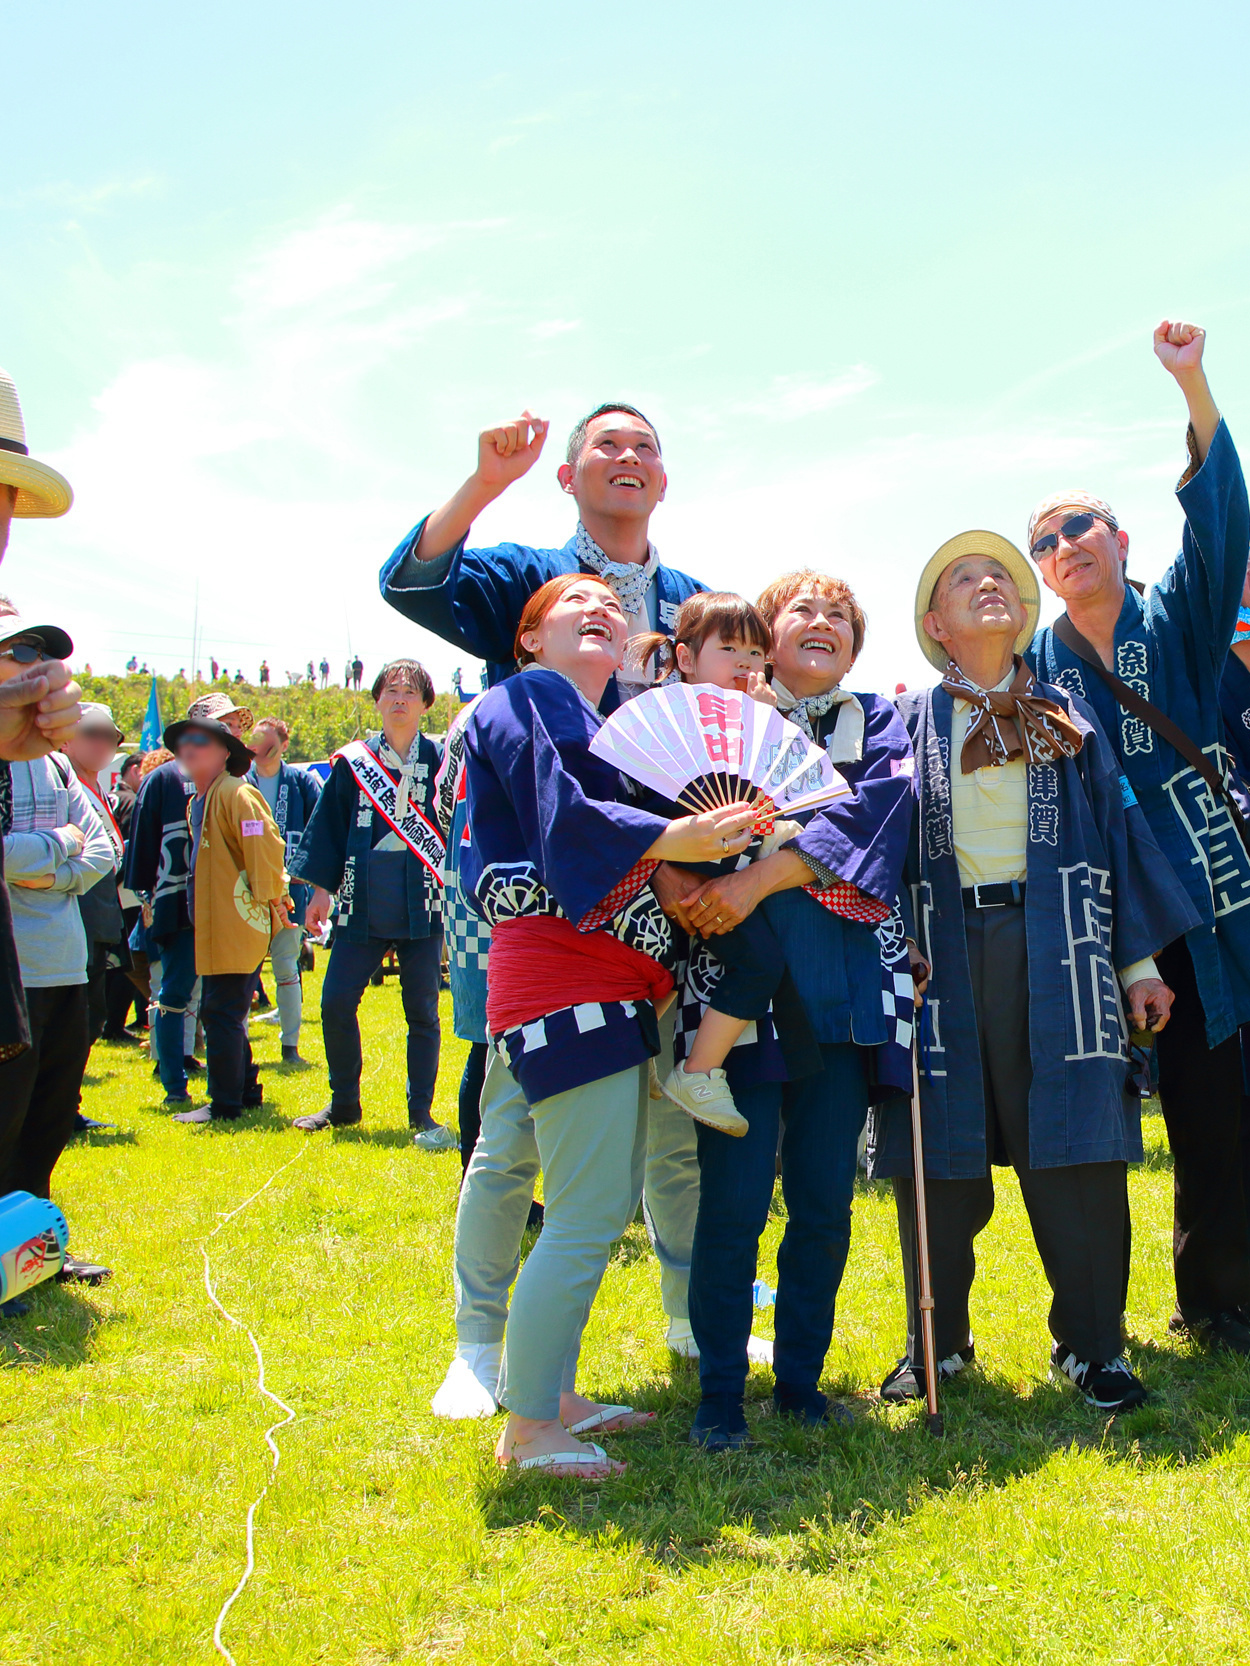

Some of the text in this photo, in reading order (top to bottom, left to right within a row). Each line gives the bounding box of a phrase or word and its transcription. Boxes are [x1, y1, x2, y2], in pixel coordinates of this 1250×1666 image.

[351, 755, 446, 869] 早出町凧会副会長
[692, 1083, 713, 1099] N
